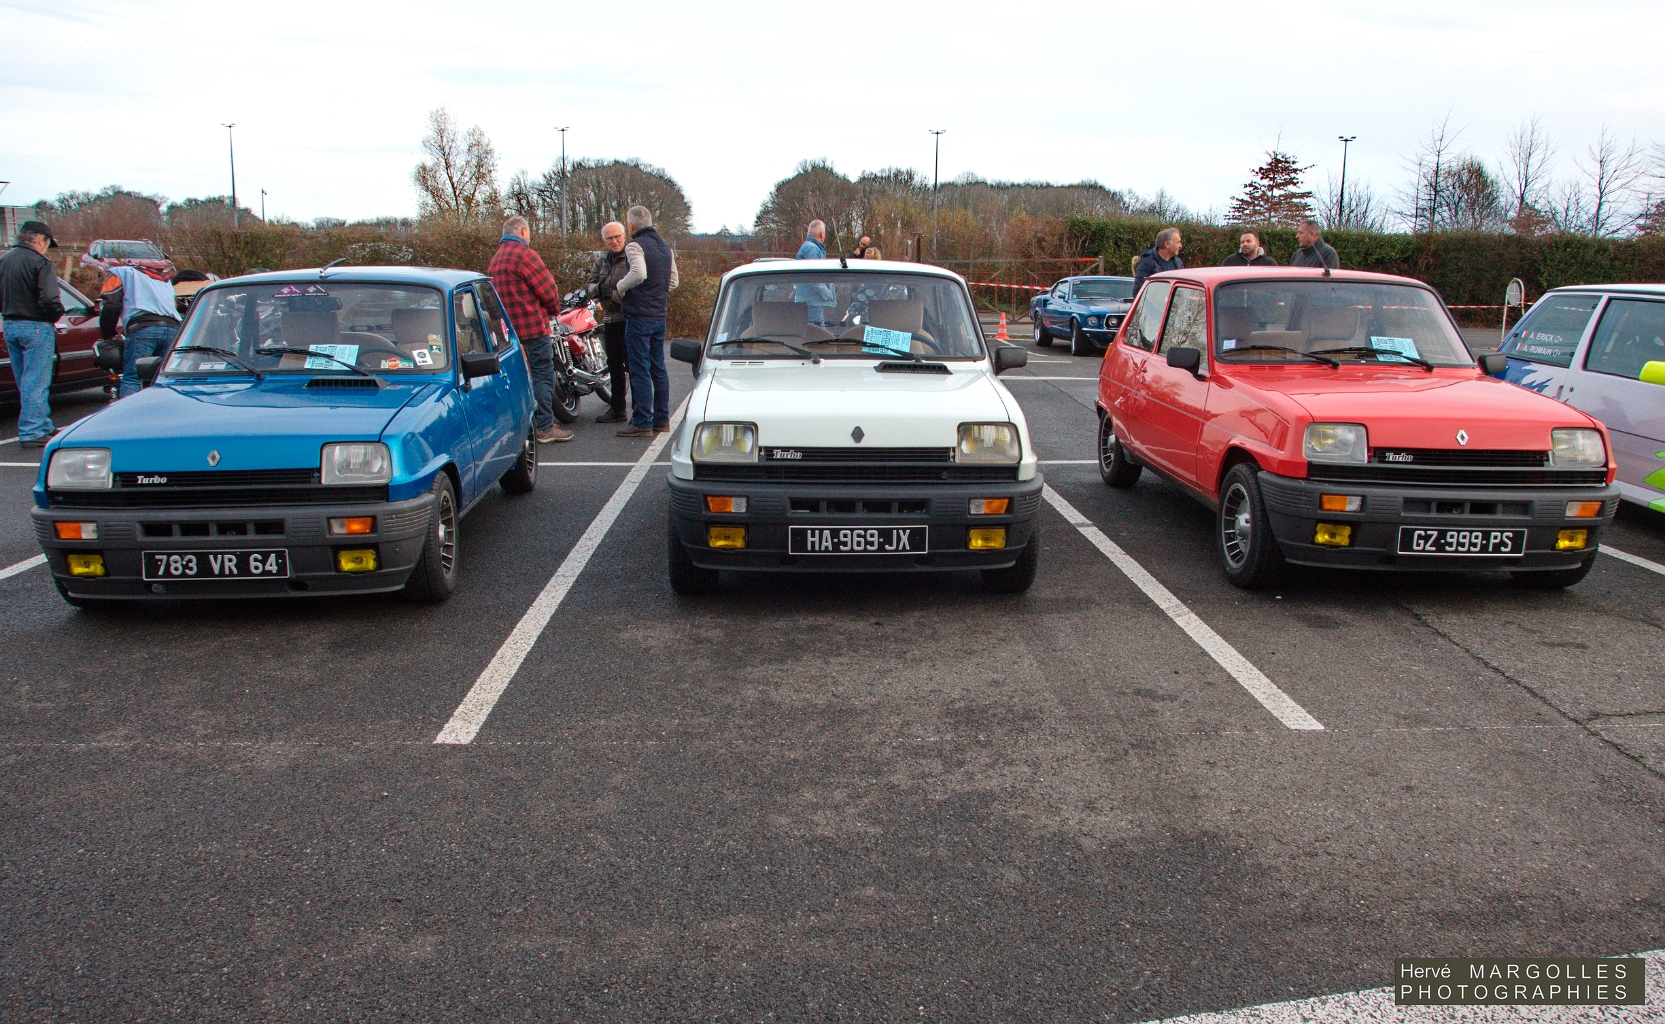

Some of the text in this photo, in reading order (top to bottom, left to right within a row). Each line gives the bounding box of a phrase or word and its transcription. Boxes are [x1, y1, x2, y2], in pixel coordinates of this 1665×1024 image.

[1536, 333, 1554, 342] ERICK
[1529, 345, 1552, 355] ROMAIN
[773, 449, 802, 459] Turbo
[1385, 452, 1413, 462] Turbo
[136, 475, 167, 484] Turbo
[806, 529, 910, 551] HA-969-JX
[1412, 530, 1513, 552] GZ-999-PS
[155, 553, 278, 575] 783 VR 64
